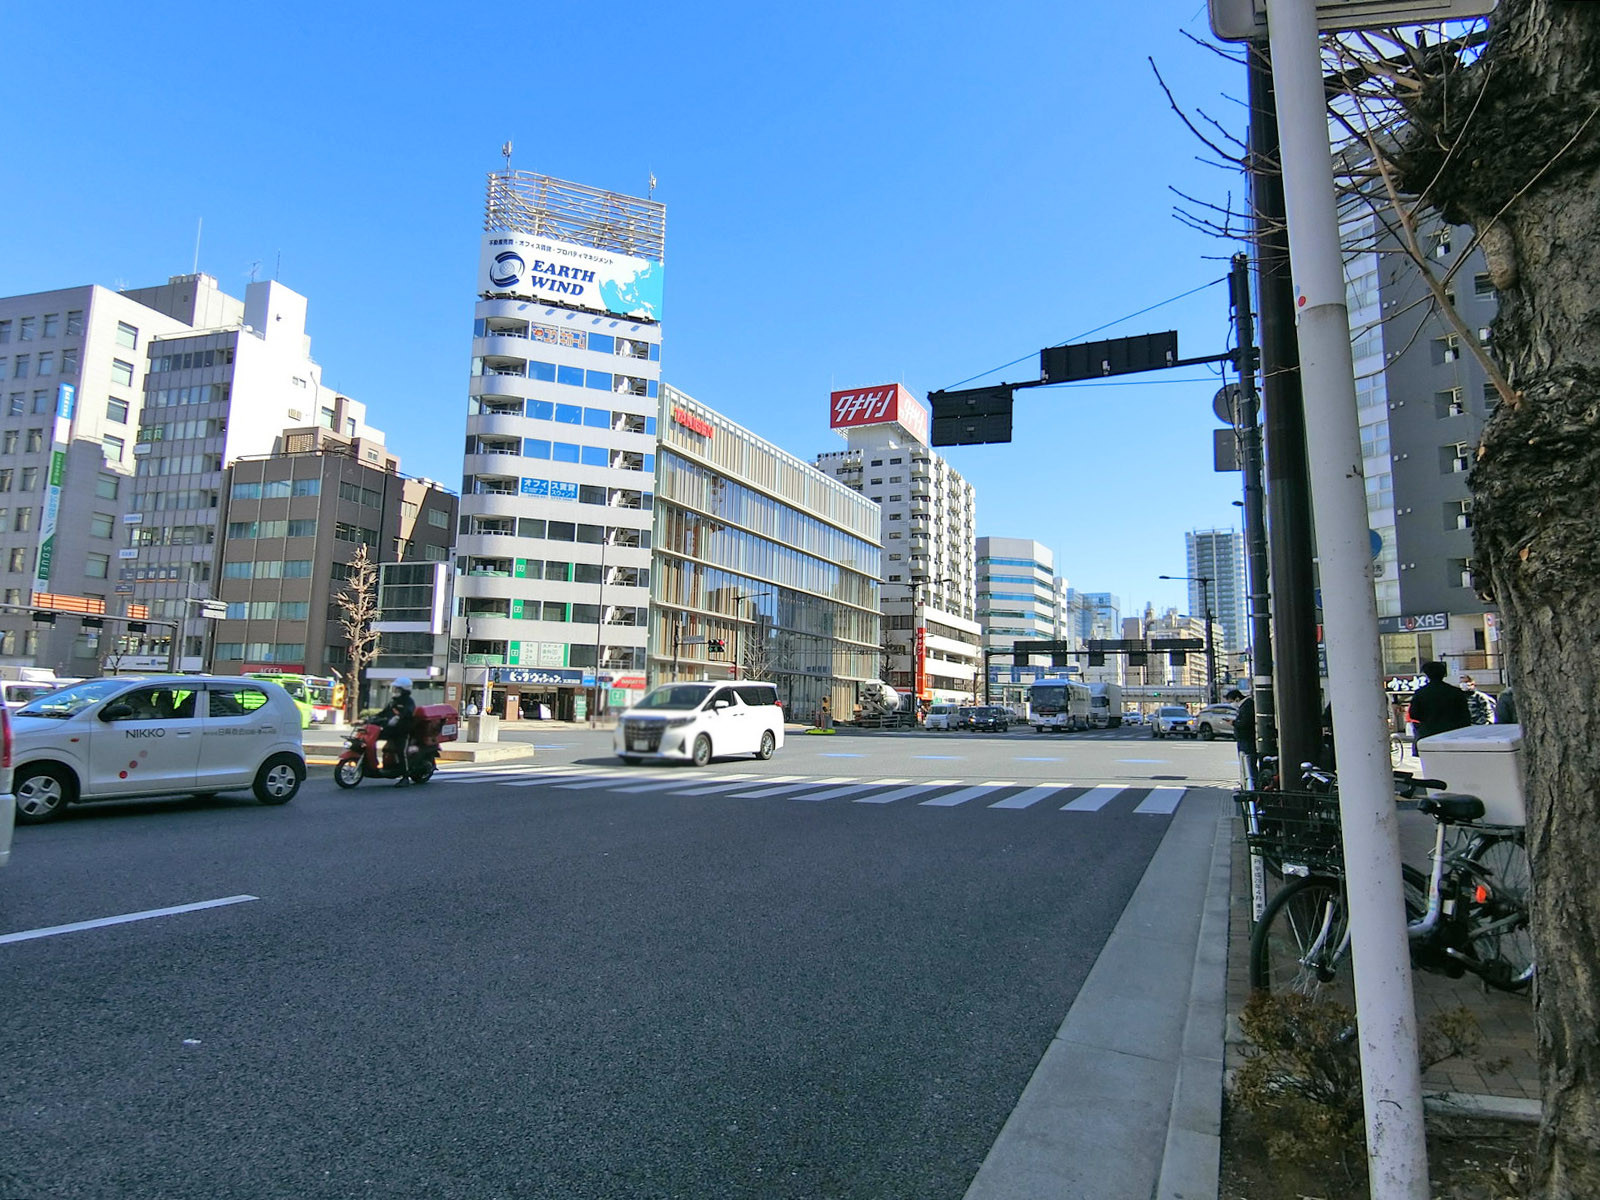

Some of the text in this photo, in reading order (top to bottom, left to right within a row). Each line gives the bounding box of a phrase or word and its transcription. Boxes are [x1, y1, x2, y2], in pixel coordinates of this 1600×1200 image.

[531, 259, 596, 283] EARTH
[530, 275, 584, 296] WIND
[834, 390, 895, 423] タキゲン
[1397, 613, 1446, 629] LUXAS
[125, 728, 166, 739] NIKKO
